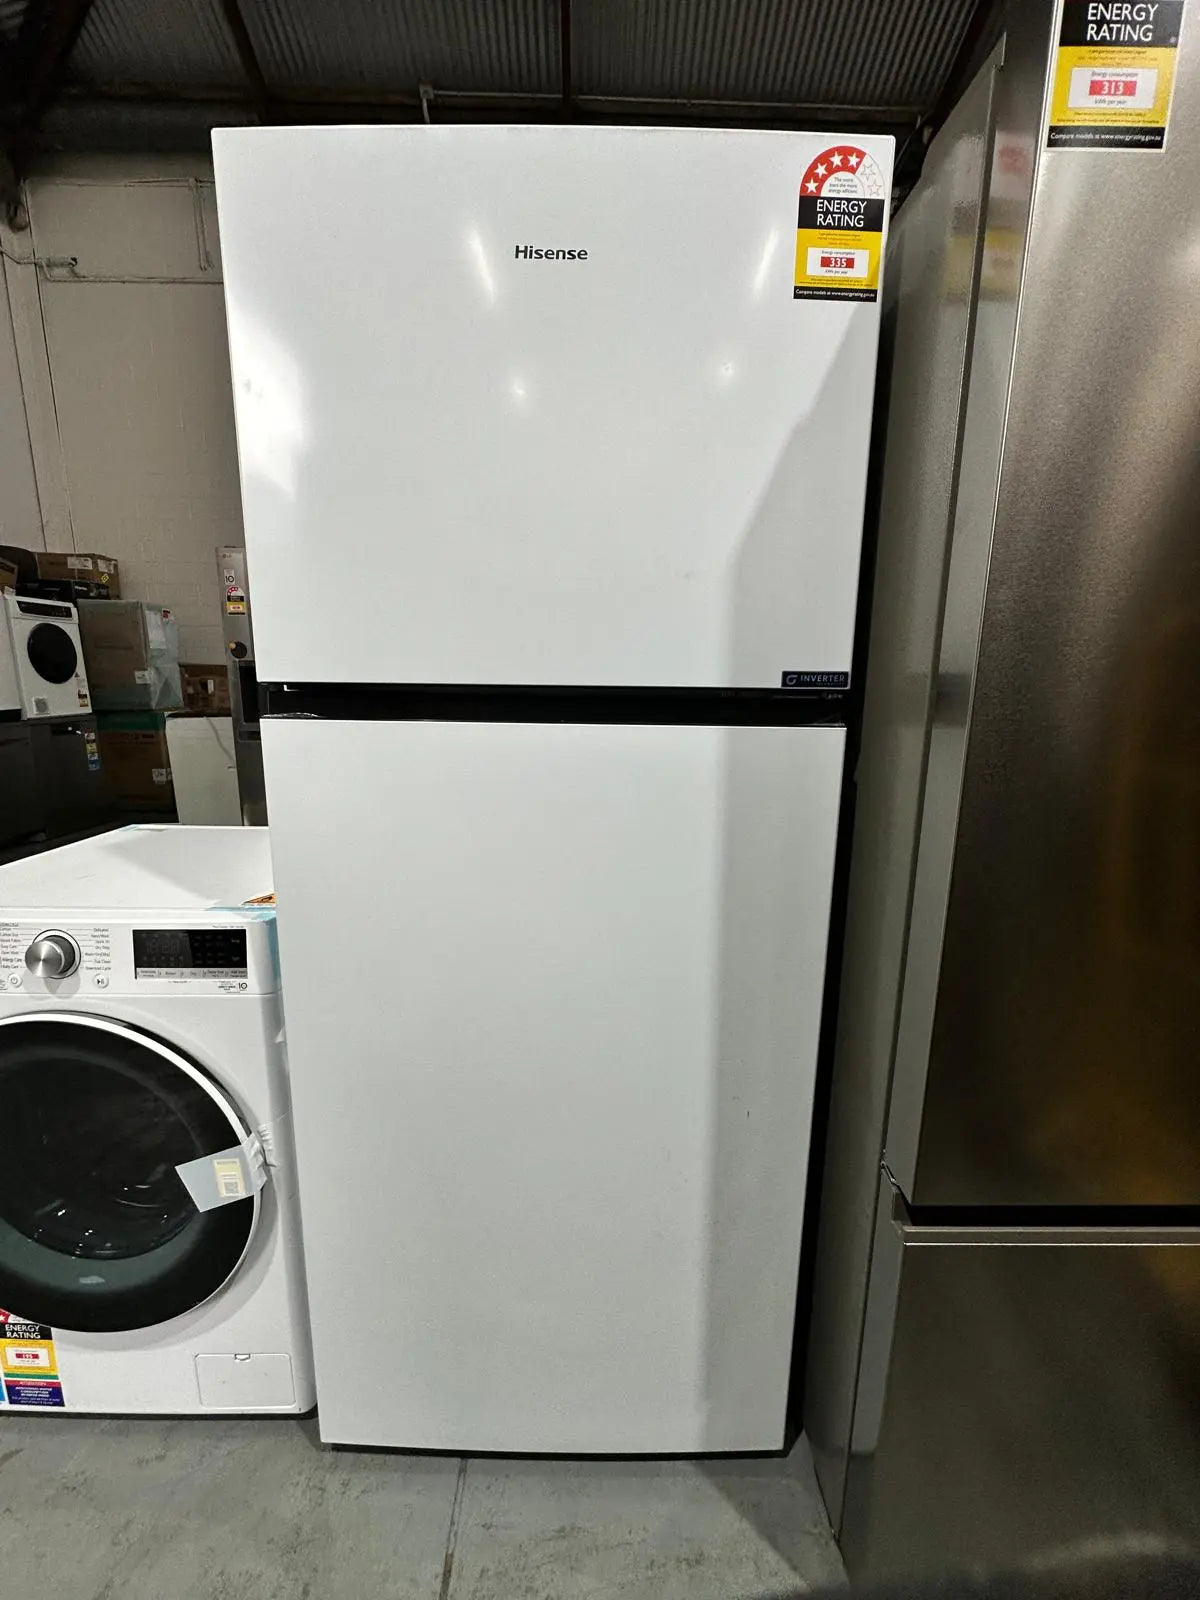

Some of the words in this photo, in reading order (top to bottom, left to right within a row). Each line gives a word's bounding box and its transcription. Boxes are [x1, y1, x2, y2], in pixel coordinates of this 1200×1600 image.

[1087, 3, 1159, 21] ENERGY
[1086, 24, 1154, 42] RATING
[1101, 81, 1124, 95] 313
[1050, 132, 1074, 141] Compare
[816, 199, 867, 214] ENERGY
[816, 214, 865, 228] RATING
[514, 245, 588, 260] Hisense
[829, 258, 847, 268] 335
[225, 575, 235, 583] 10
[5, 1324, 40, 1332] ENERGY
[6, 1331, 41, 1339] RATING
